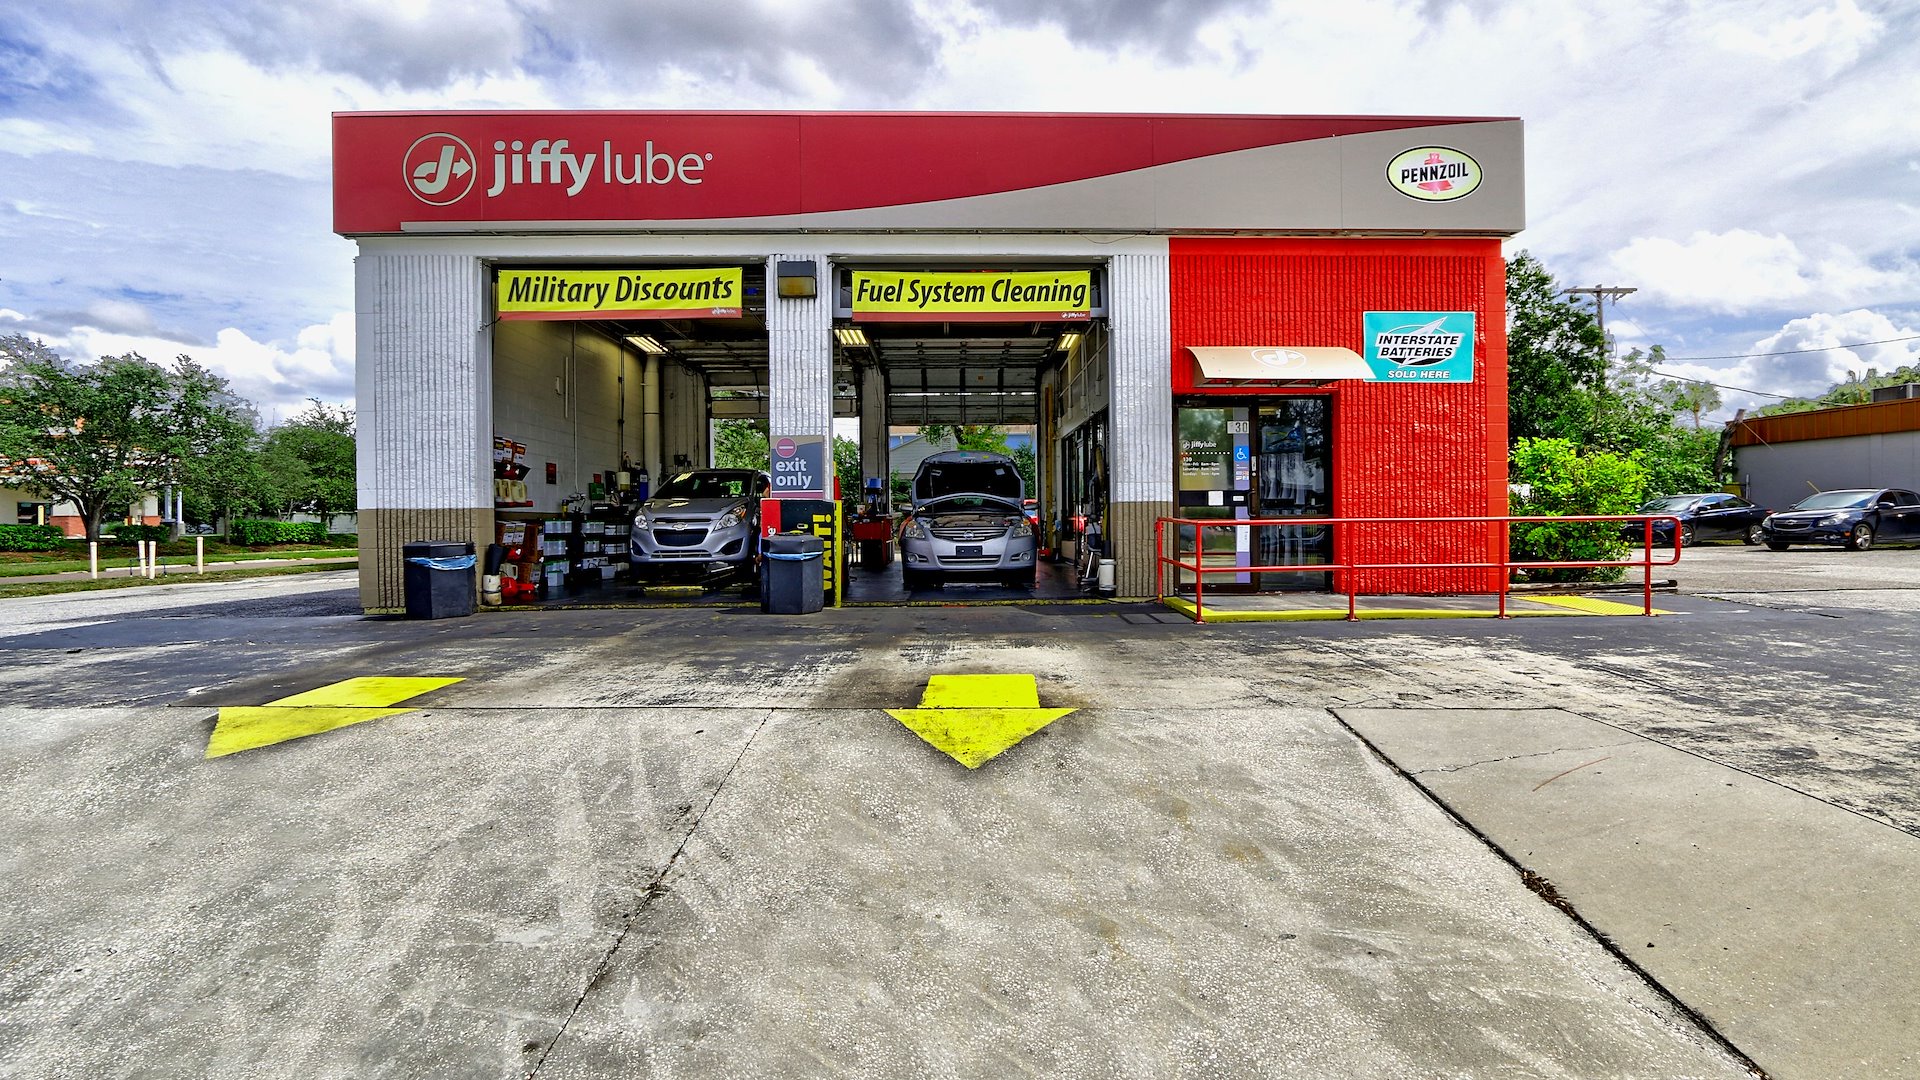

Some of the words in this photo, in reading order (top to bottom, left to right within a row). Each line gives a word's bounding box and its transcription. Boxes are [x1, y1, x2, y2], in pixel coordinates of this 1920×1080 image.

[487, 139, 597, 197] jiffy
[1401, 162, 1469, 184] PENNZOIL
[507, 274, 610, 309] Military
[614, 275, 733, 303] Discounts
[856, 279, 904, 302] Fuel
[907, 279, 986, 309] System
[991, 278, 1087, 308] Cleaning
[1378, 335, 1459, 345] INTERSTATE
[1381, 346, 1453, 357] BATTERIES
[1387, 369, 1418, 379] SOLD
[1419, 369, 1450, 379] HERE
[775, 457, 807, 472] exit
[775, 472, 812, 489] only
